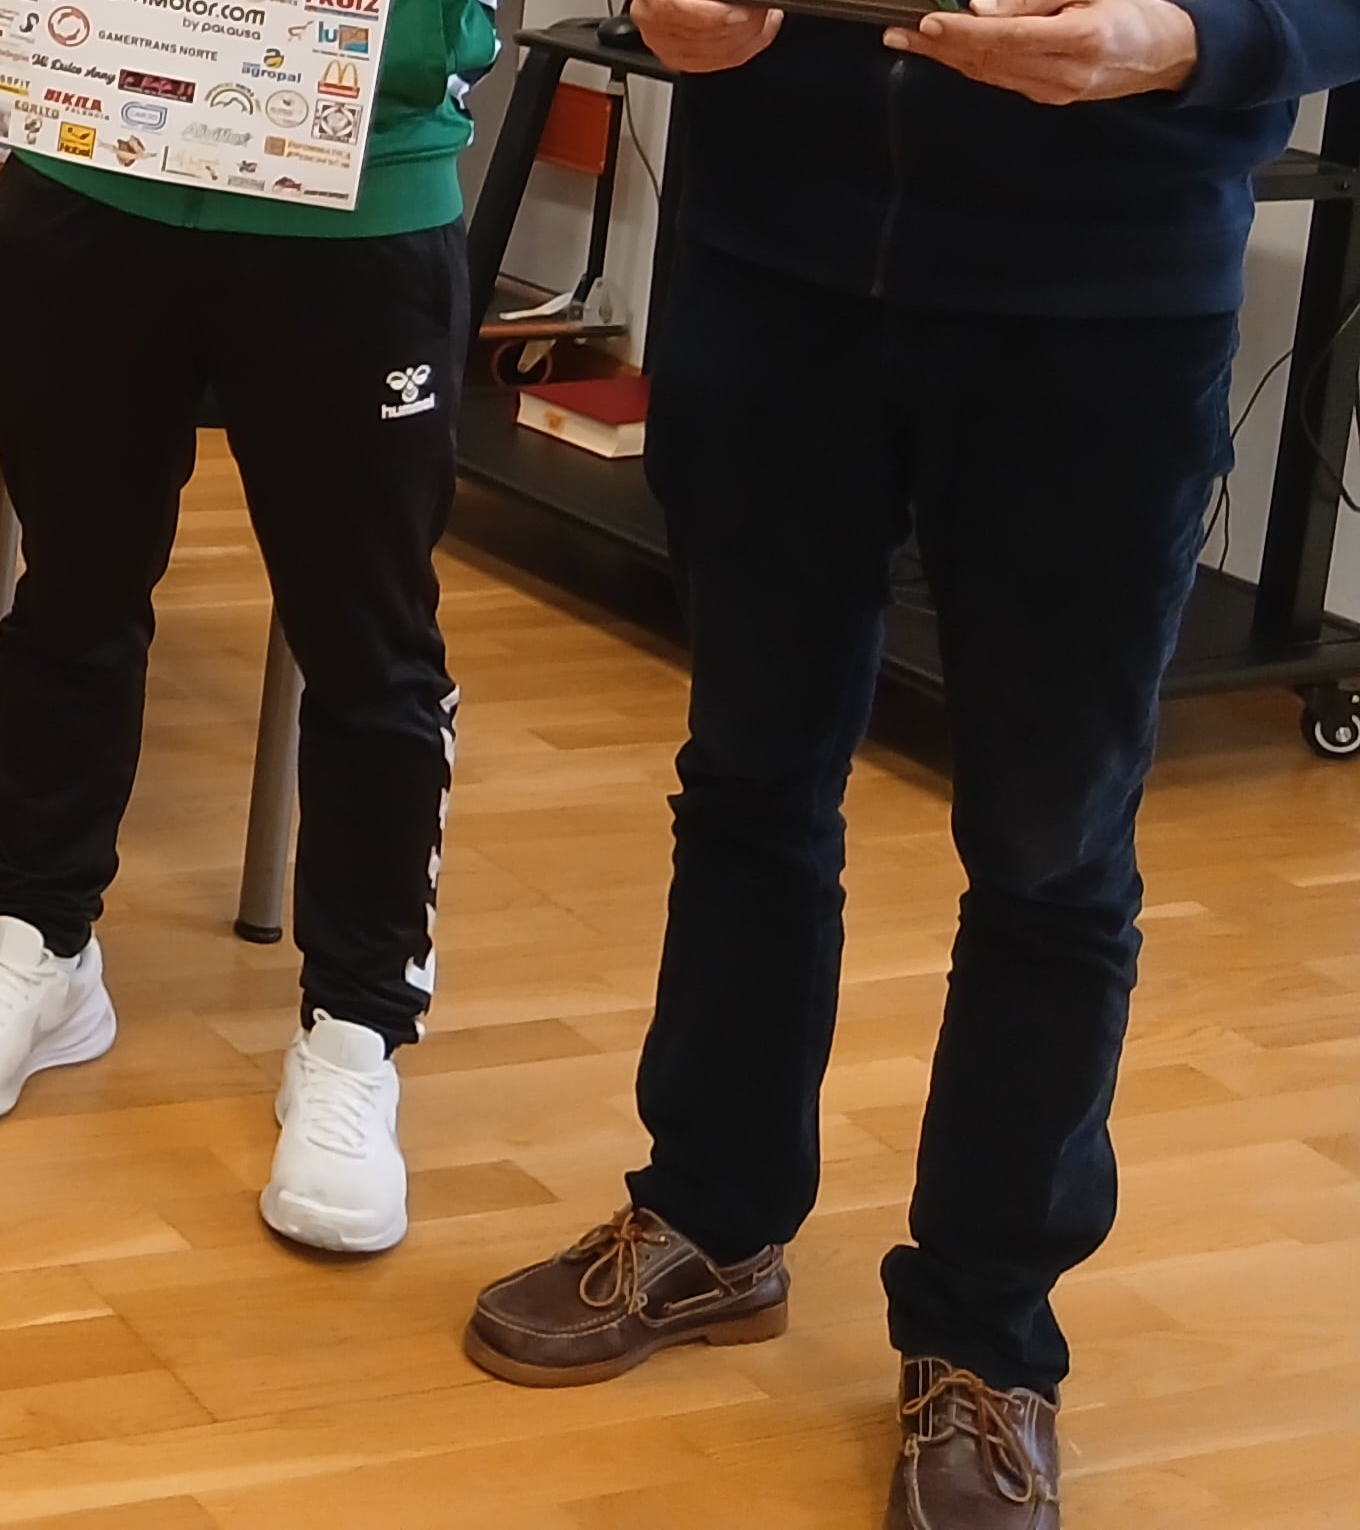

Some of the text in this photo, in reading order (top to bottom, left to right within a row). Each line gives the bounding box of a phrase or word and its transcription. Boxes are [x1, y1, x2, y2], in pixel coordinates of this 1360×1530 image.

[182, 17, 200, 32] by
[98, 30, 219, 62] GAMERTRANS NORTE
[242, 66, 302, 84] agropal
